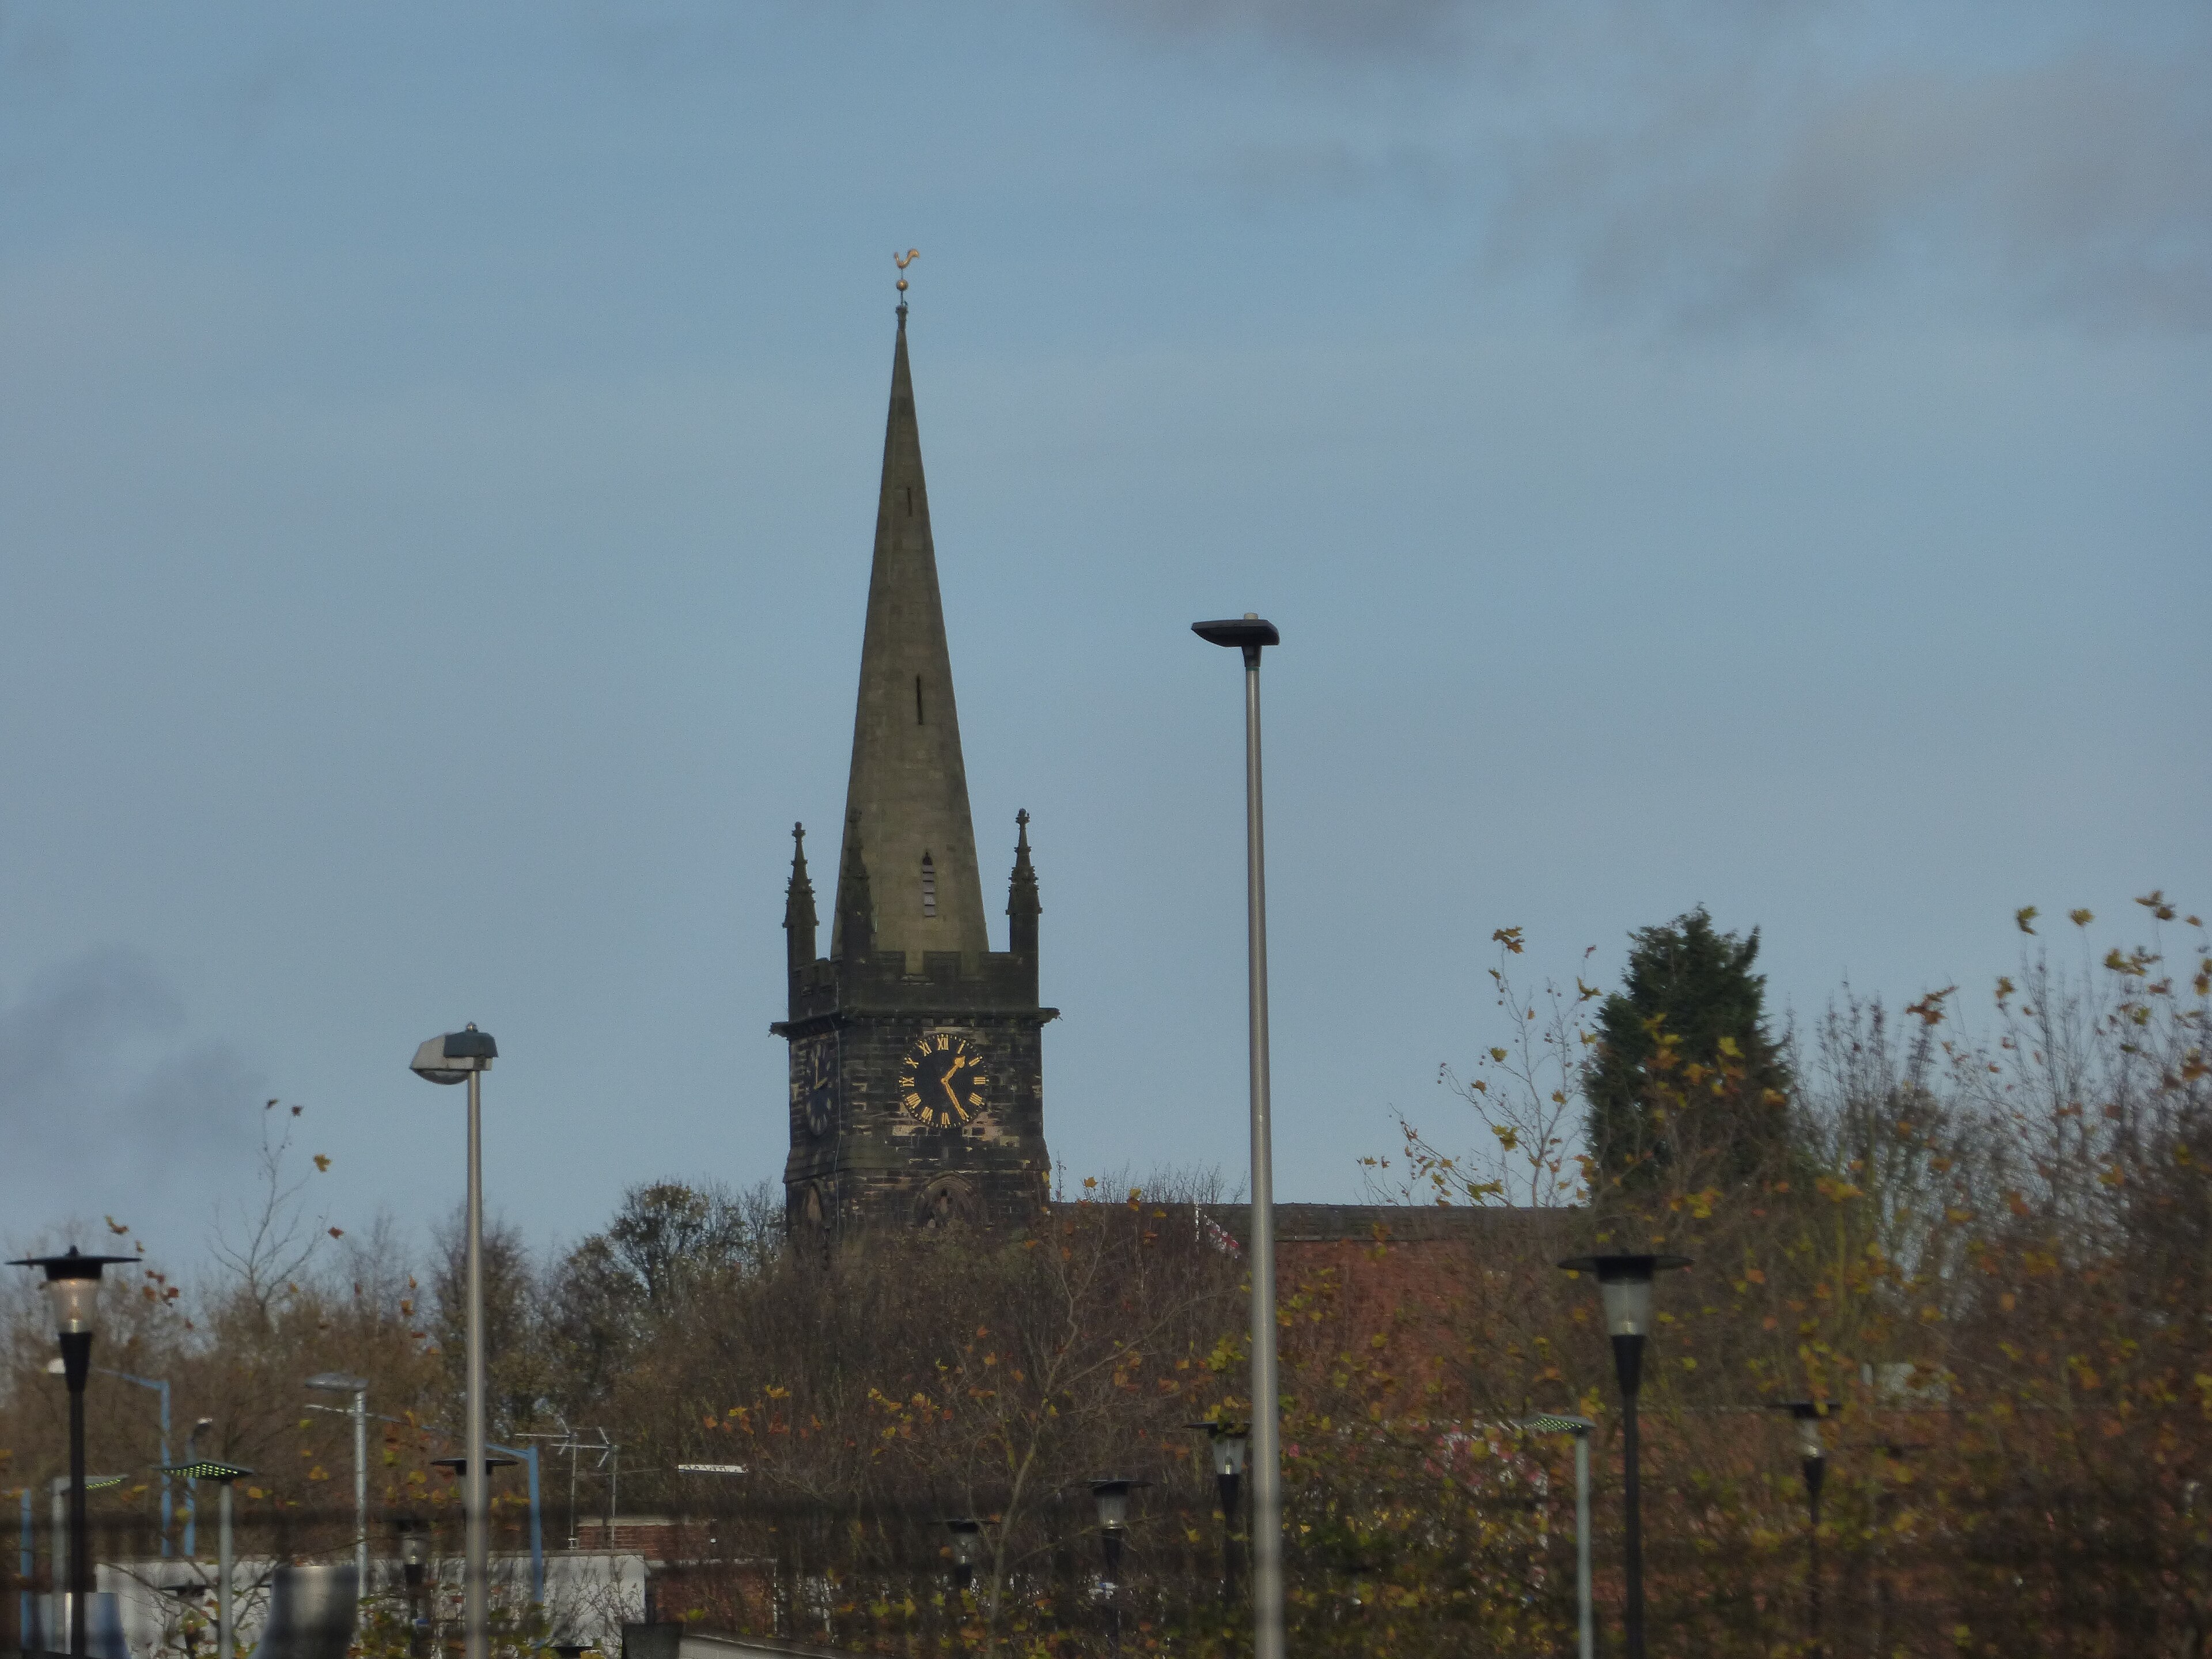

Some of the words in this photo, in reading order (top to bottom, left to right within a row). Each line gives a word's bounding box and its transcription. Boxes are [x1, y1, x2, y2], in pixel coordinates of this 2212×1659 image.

[916, 1040, 931, 1056] XI
[937, 1037, 949, 1050] XII
[958, 1040, 965, 1054] I
[905, 1057, 919, 1069] X
[969, 1056, 982, 1066] II
[902, 1077, 915, 1086] IX
[974, 1077, 986, 1085] III
[907, 1093, 922, 1108] VIII
[922, 1107, 933, 1121] VII
[941, 1112, 950, 1124] VI
